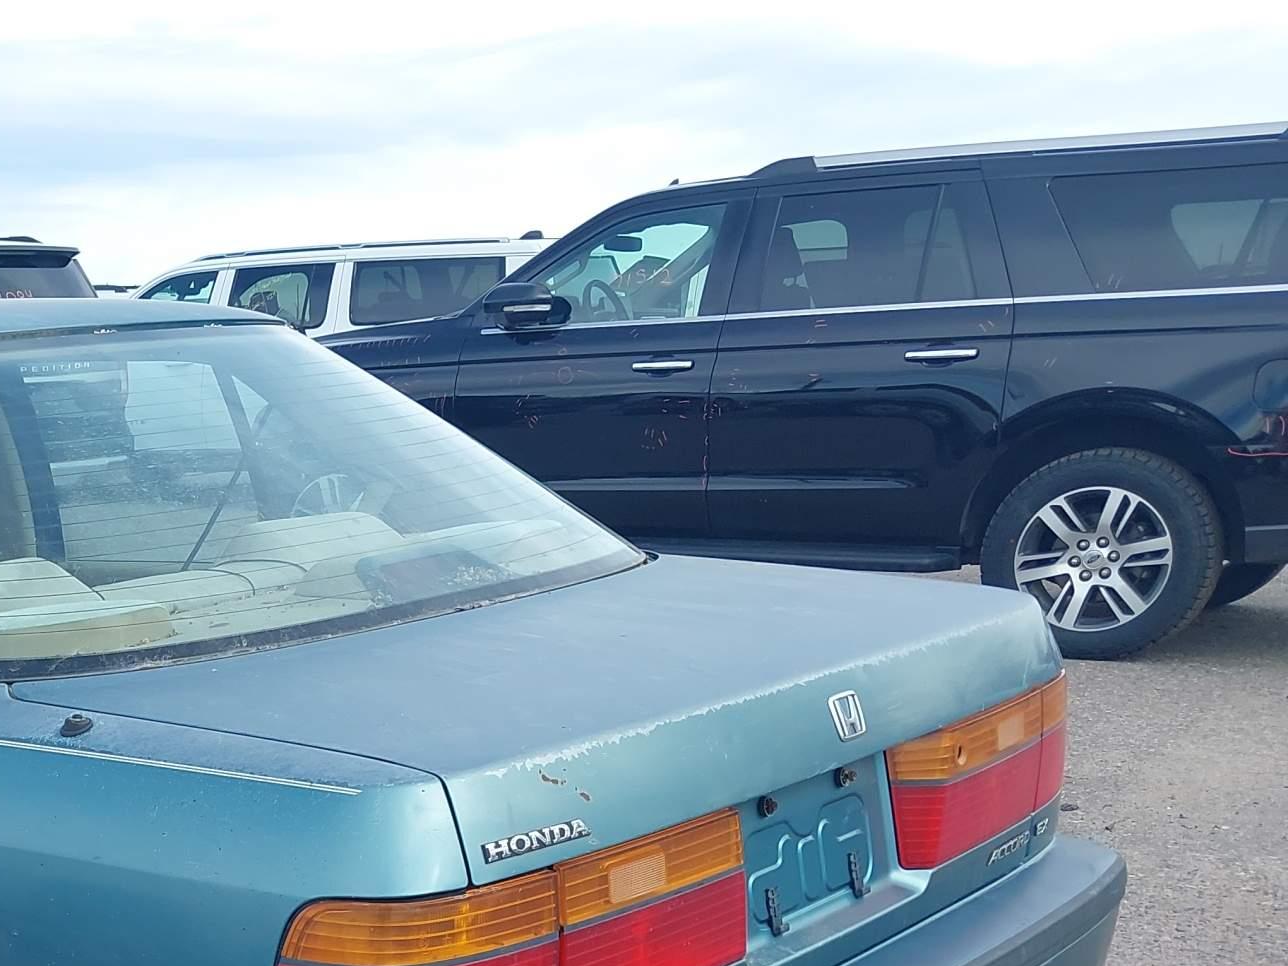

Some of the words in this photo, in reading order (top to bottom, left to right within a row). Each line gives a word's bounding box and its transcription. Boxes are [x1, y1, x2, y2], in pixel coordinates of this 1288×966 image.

[485, 818, 590, 862] HONDA
[986, 830, 1030, 866] ACCORD
[1034, 818, 1049, 836] EX
